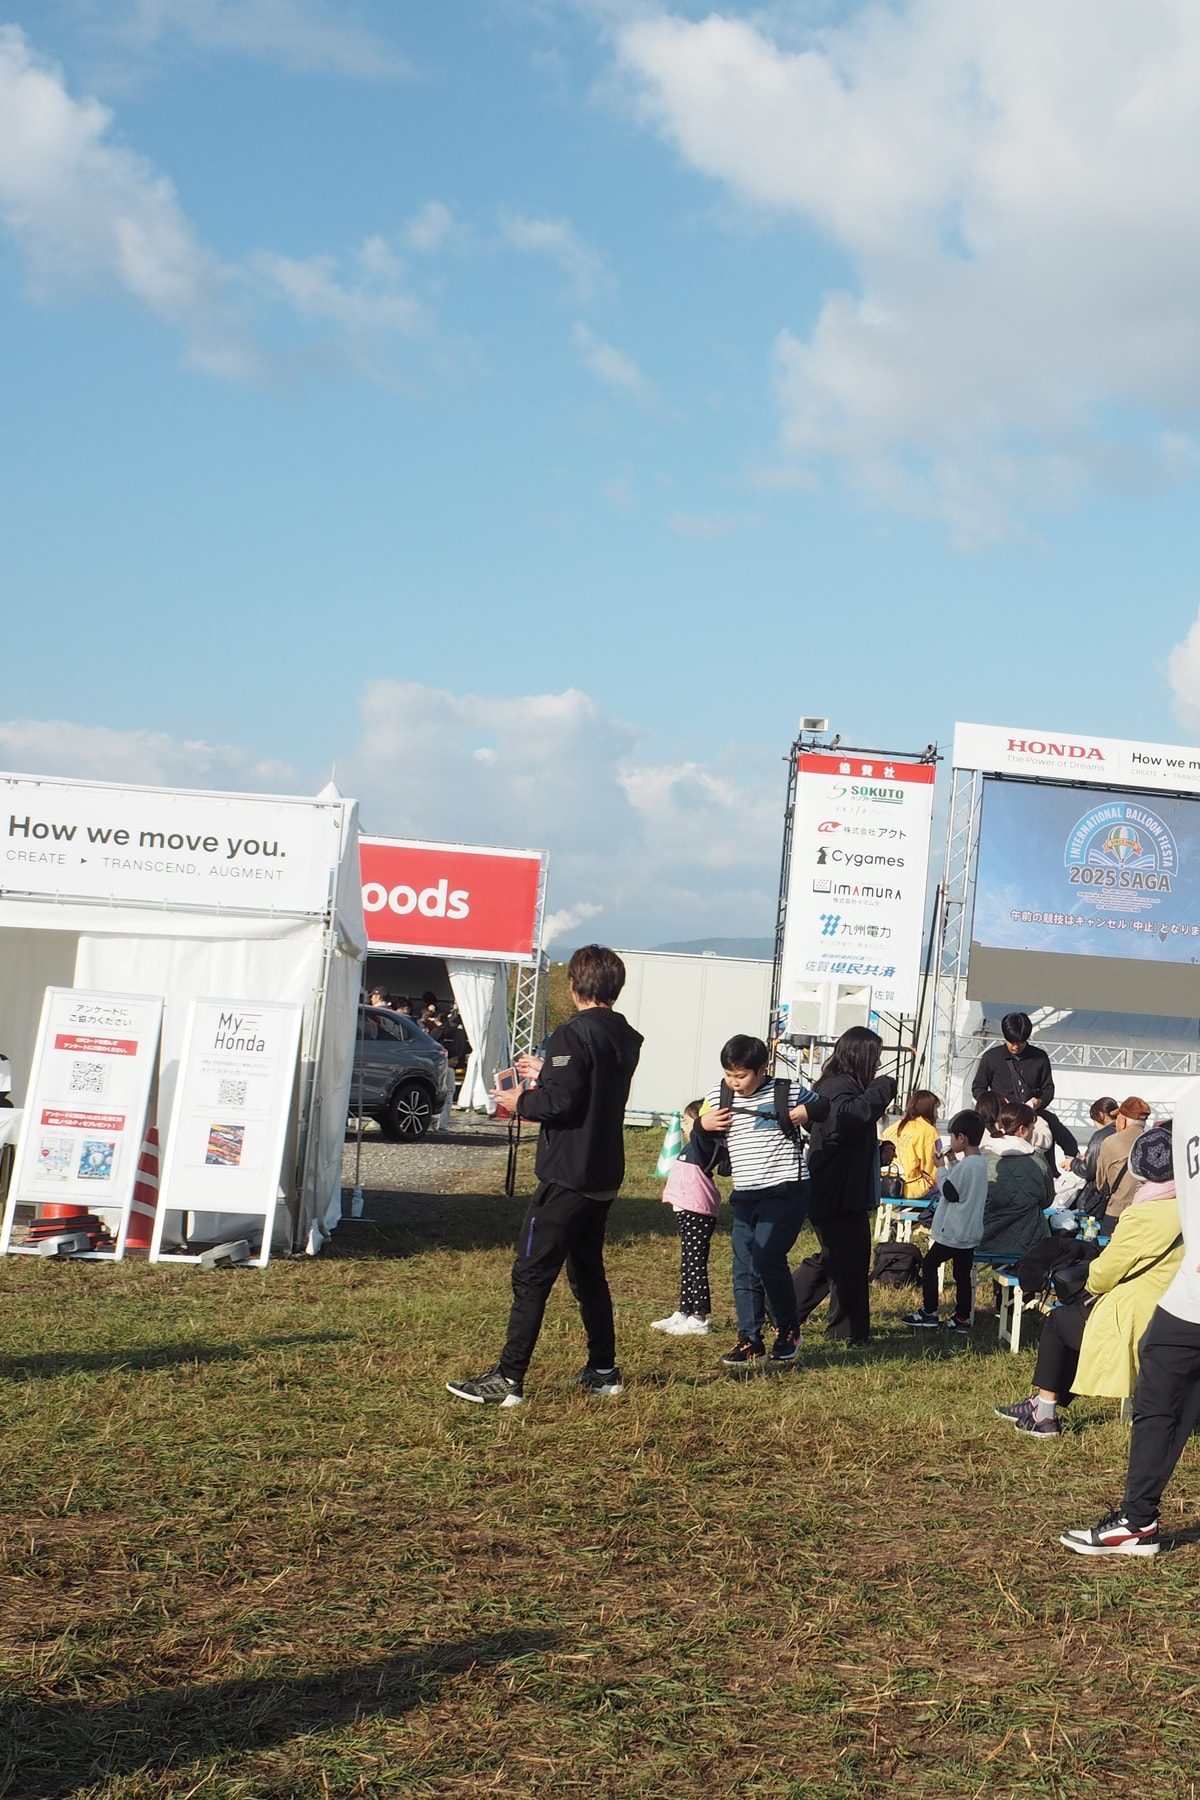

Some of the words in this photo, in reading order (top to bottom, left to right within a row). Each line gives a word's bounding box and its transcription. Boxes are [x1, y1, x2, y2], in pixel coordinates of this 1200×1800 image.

[1007, 739, 1106, 761] HONDA
[1132, 752, 1162, 766] How
[1166, 757, 1186, 768] we
[1007, 754, 1024, 763] The
[1026, 756, 1055, 767] Power
[1056, 760, 1068, 768] of
[1069, 760, 1105, 772] Dreams
[851, 785, 904, 800] SOKUTO
[8, 814, 77, 842] How
[86, 826, 130, 846] we
[139, 831, 219, 853] move
[226, 837, 287, 859] you.
[1070, 807, 1122, 858] INTERNATIONAL
[1125, 807, 1164, 837] BALLOON
[1158, 835, 1173, 867] FIESTA
[6, 849, 67, 865] CREATE
[103, 857, 201, 876] TRANSCEND,
[208, 865, 284, 881] AUGMENT
[831, 849, 905, 868] Cygames
[1070, 867, 1116, 887] 2025
[1119, 871, 1171, 892] SAGA
[361, 878, 470, 919] oods
[840, 923, 892, 939] 九州電力
[69, 1014, 132, 1026] ご協力ください
[76, 1004, 128, 1016] アンケートに
[218, 1012, 243, 1035] My
[214, 1031, 265, 1052] Honda
